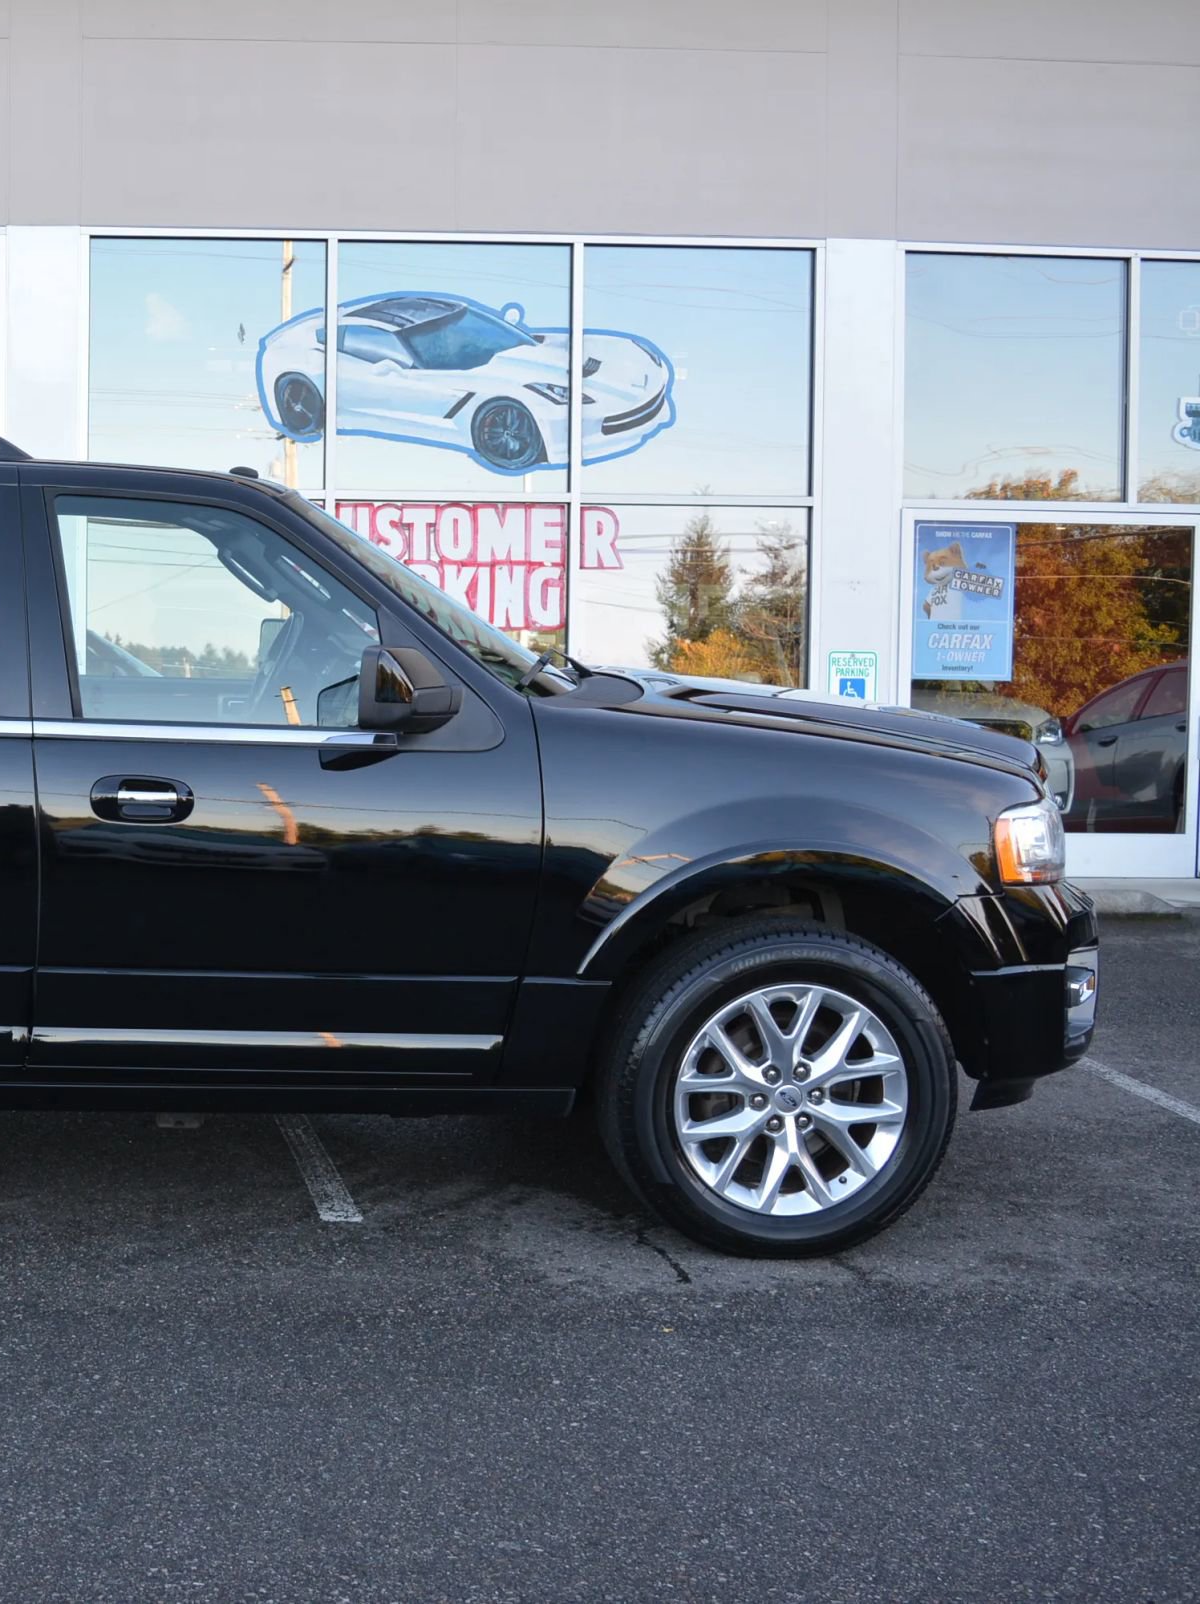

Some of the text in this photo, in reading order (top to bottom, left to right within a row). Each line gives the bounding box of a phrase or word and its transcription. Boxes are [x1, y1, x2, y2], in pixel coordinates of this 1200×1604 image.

[954, 569, 1003, 589] CARFAX
[937, 623, 957, 631] Check
[928, 632, 993, 650] CARFAX
[832, 657, 874, 667] RESERVED
[835, 667, 870, 677] PARKING
